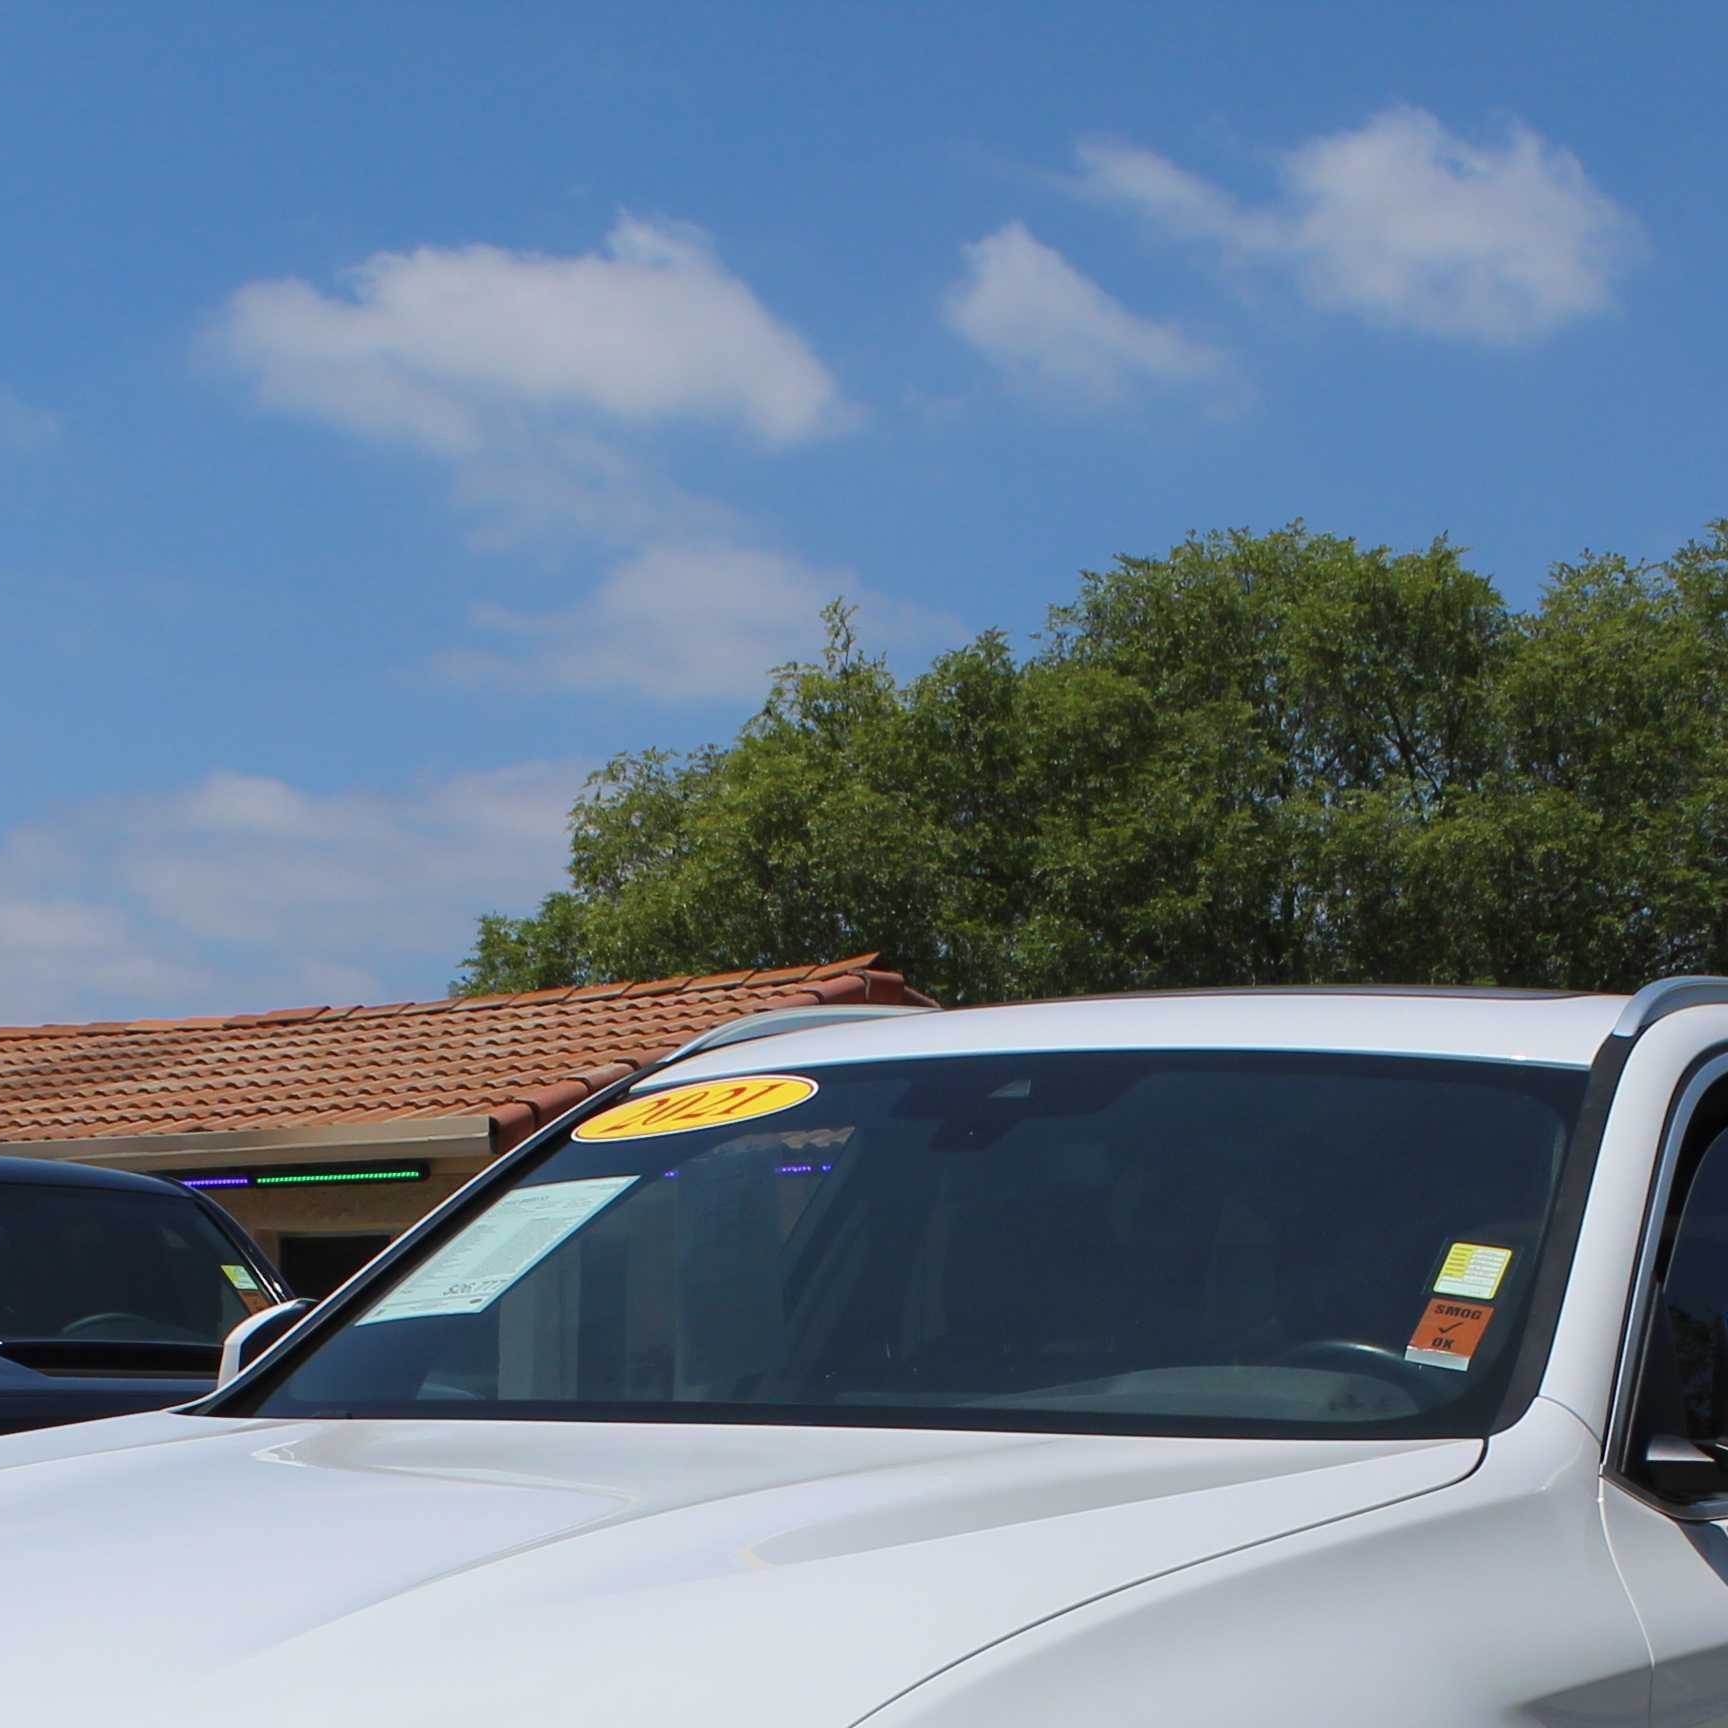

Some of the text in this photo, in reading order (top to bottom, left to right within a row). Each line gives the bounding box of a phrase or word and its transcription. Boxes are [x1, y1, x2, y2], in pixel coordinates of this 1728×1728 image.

[599, 1083, 785, 1134] 2021
[1434, 1304, 1483, 1320] SMOG
[1431, 1336, 1456, 1350] OK
